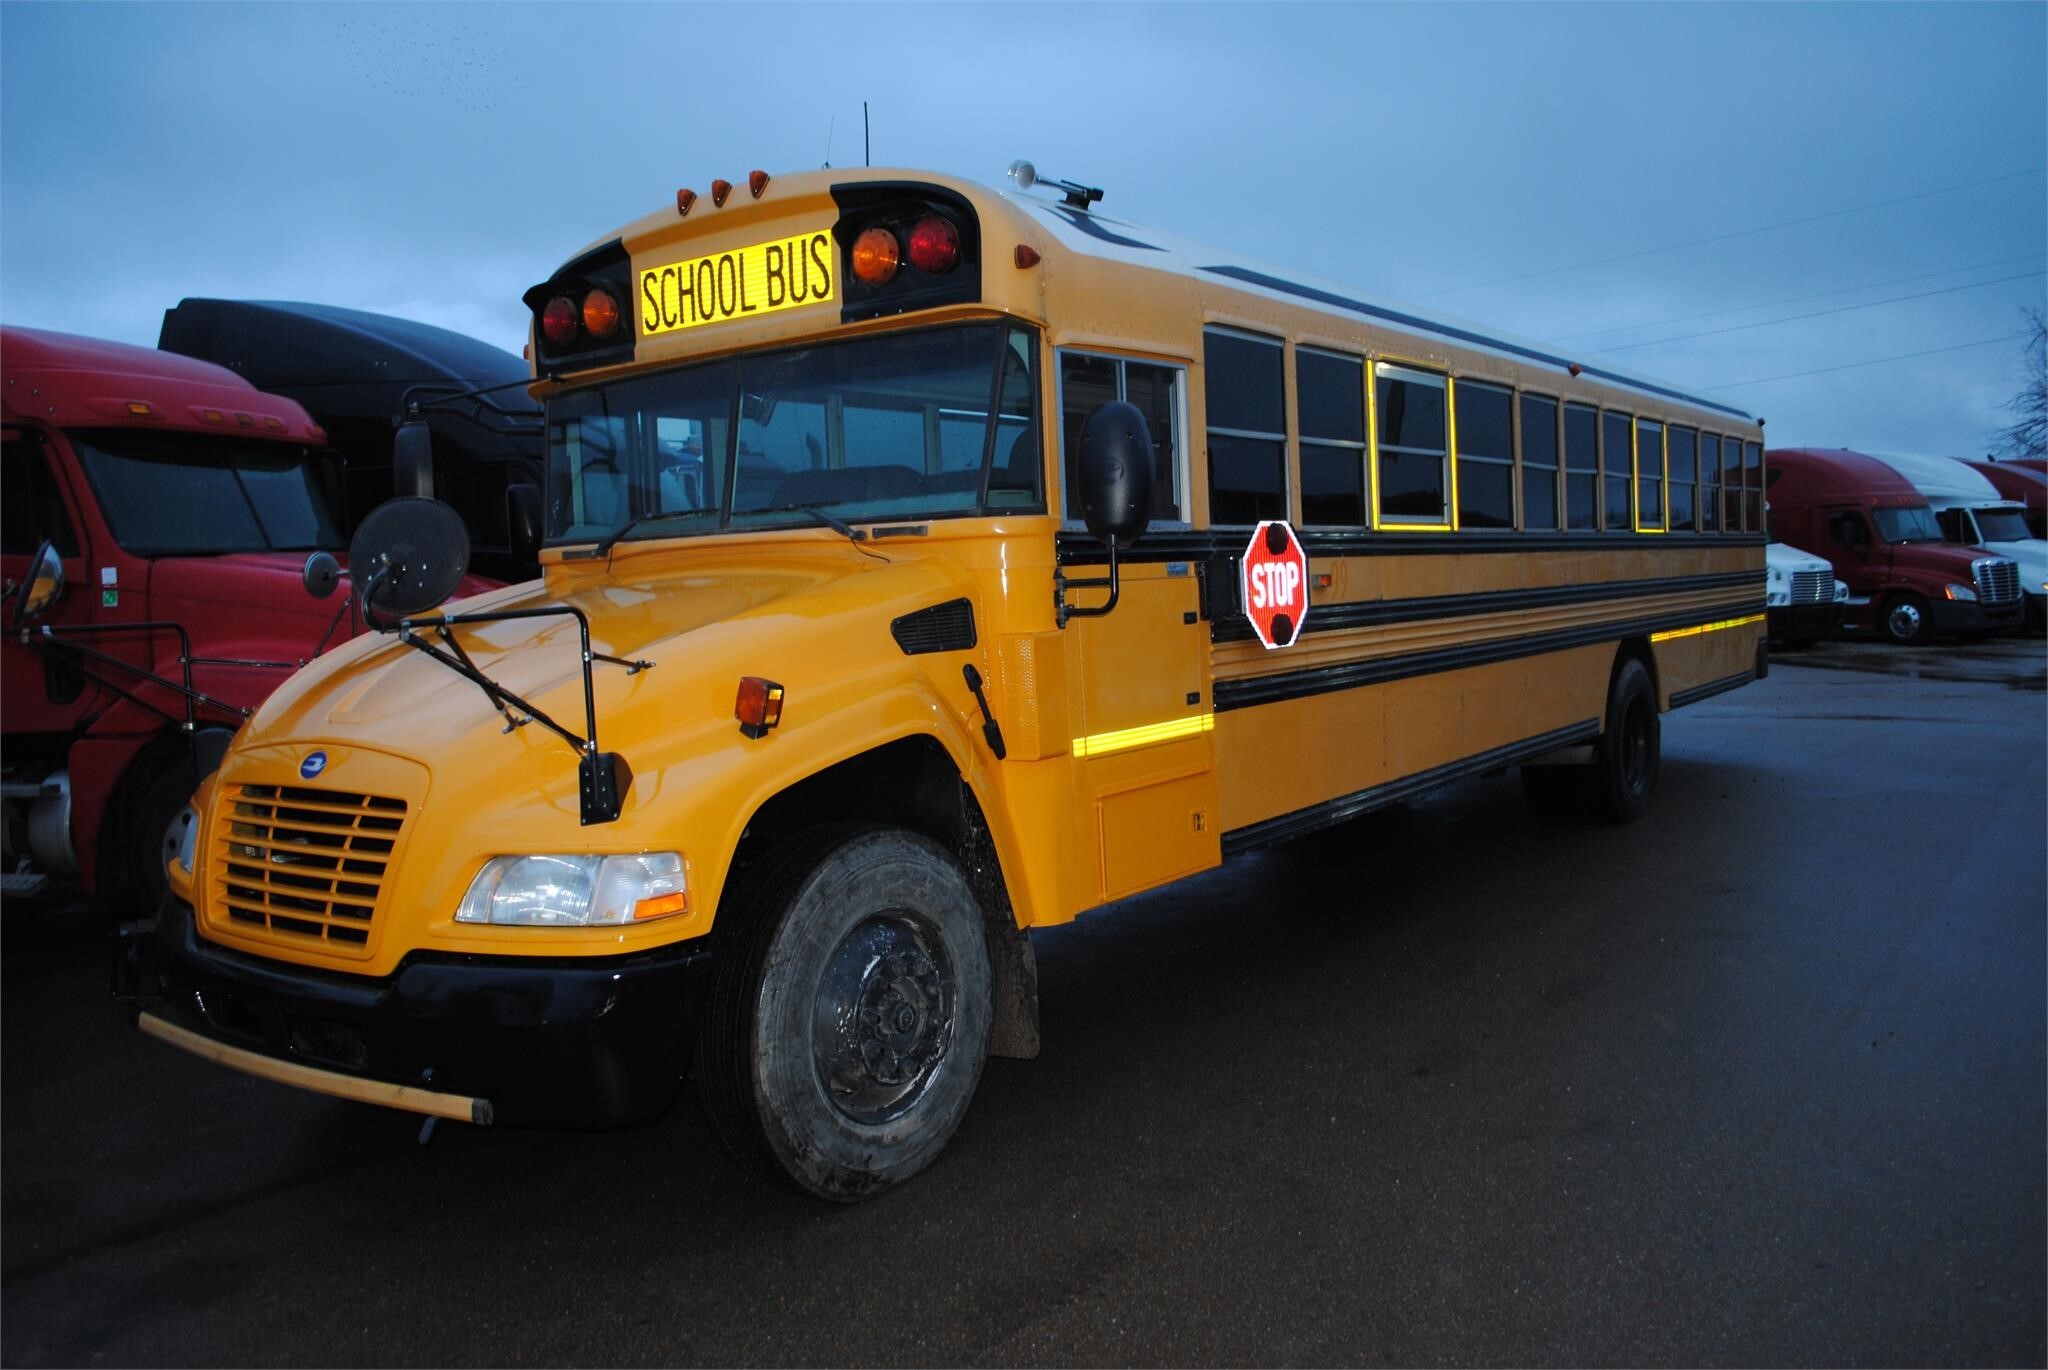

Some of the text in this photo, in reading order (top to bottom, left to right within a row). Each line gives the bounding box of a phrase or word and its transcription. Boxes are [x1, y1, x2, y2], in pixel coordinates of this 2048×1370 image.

[643, 234, 830, 331] SCHOOL BUS
[1252, 561, 1299, 608] STOP
